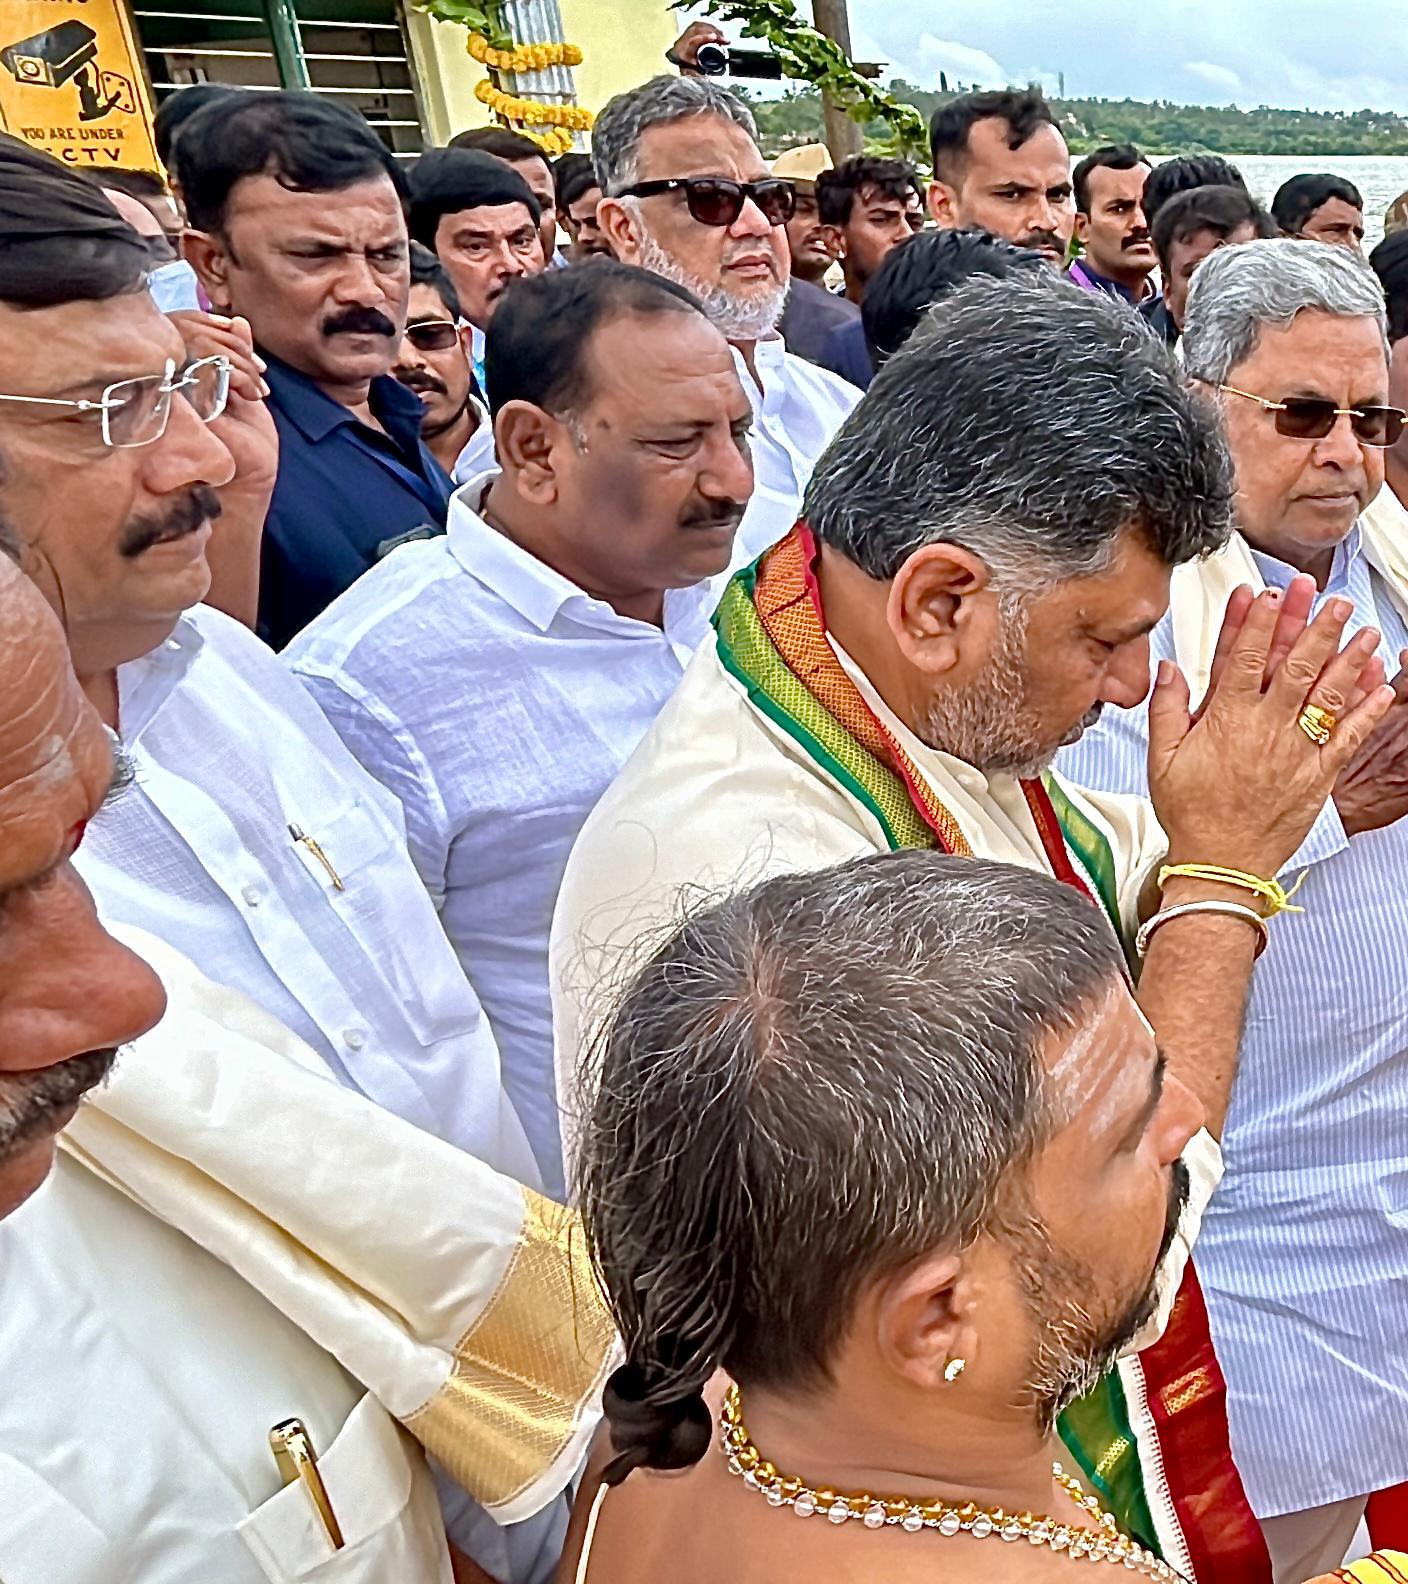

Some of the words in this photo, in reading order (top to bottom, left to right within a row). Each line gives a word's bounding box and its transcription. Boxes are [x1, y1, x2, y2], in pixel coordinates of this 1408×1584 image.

[50, 128, 76, 140] ARE
[78, 128, 125, 140] UNDER
[46, 147, 120, 161] CTV
